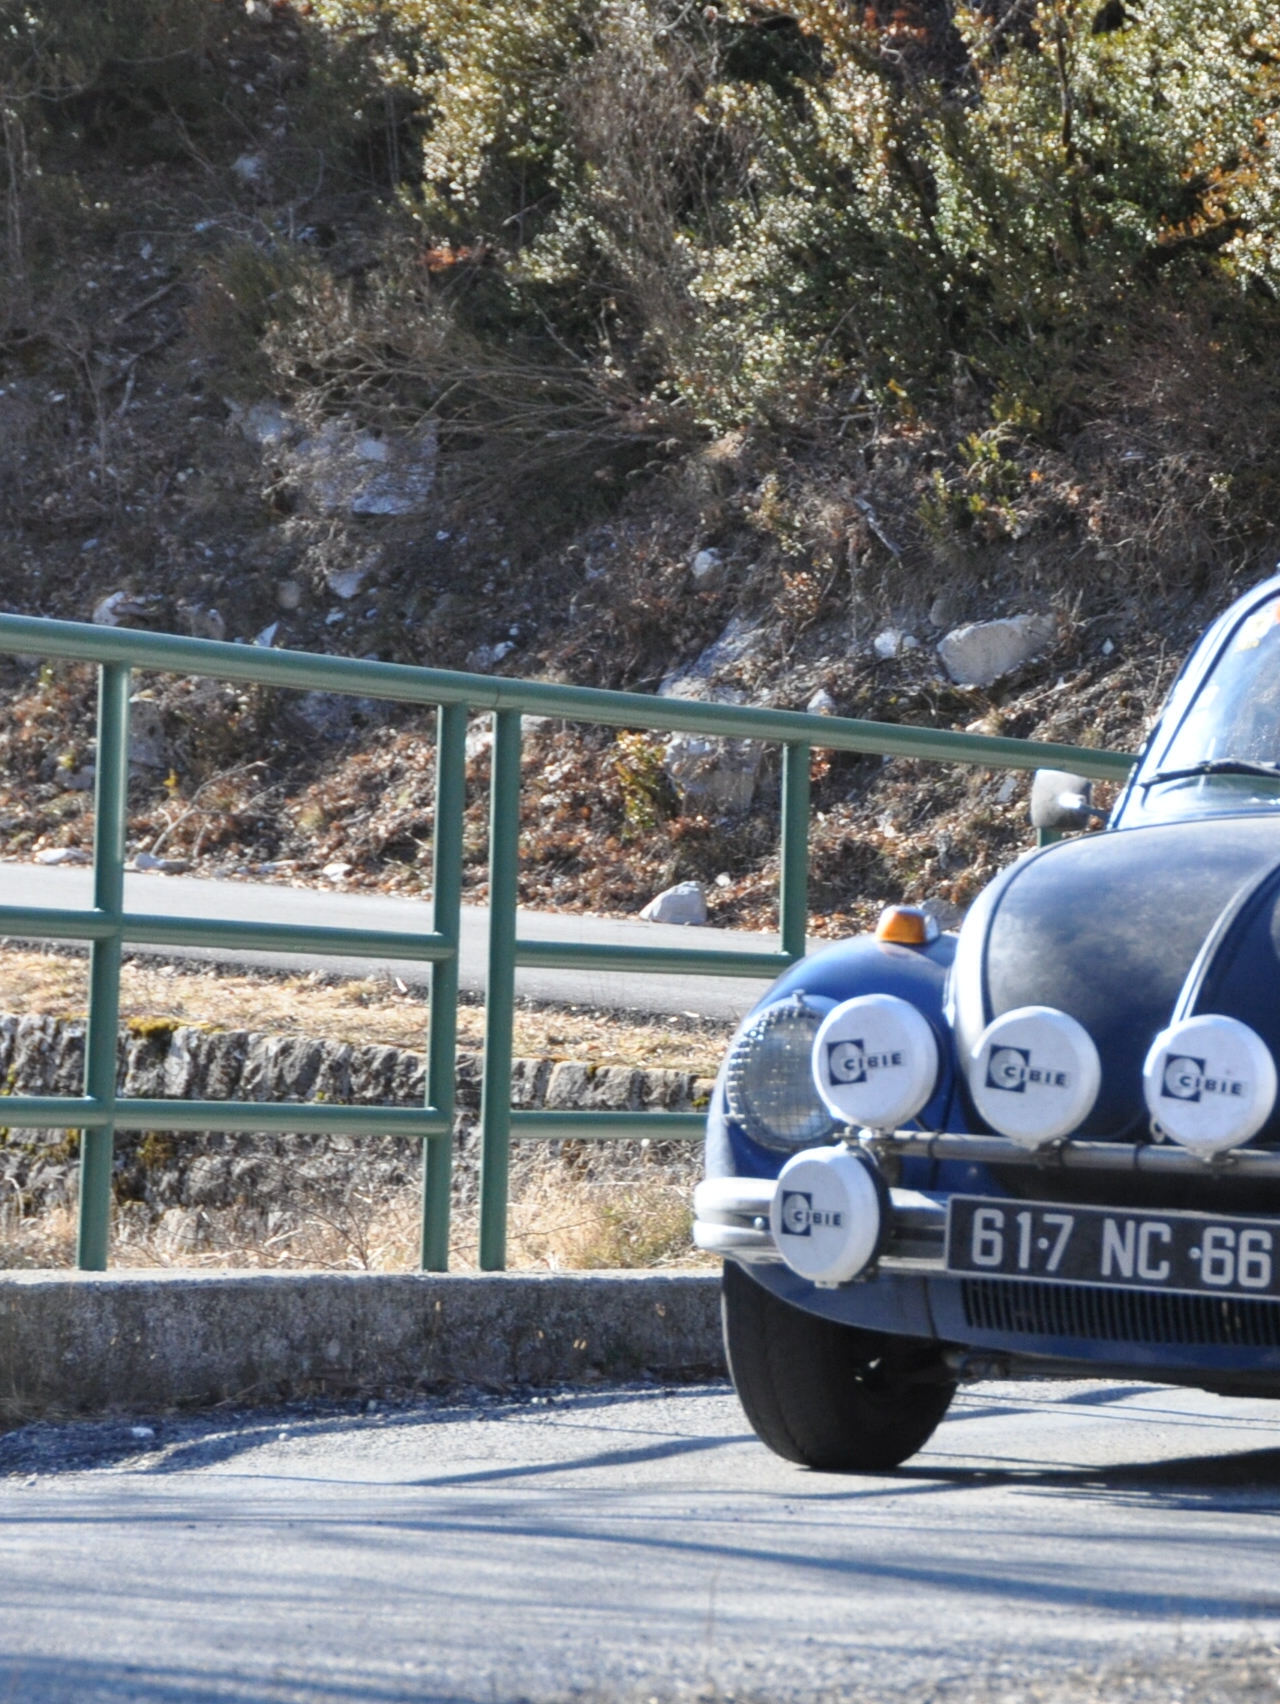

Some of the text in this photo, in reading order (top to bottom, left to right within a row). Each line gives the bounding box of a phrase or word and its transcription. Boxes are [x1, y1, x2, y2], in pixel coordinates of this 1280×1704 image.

[843, 1052, 903, 1072] CIBIE
[1003, 1065, 1067, 1086] CIBIE
[1179, 1074, 1243, 1096] CIBIE
[794, 1210, 842, 1227] CIBIE
[971, 1207, 1273, 1288] 617 NC 66
